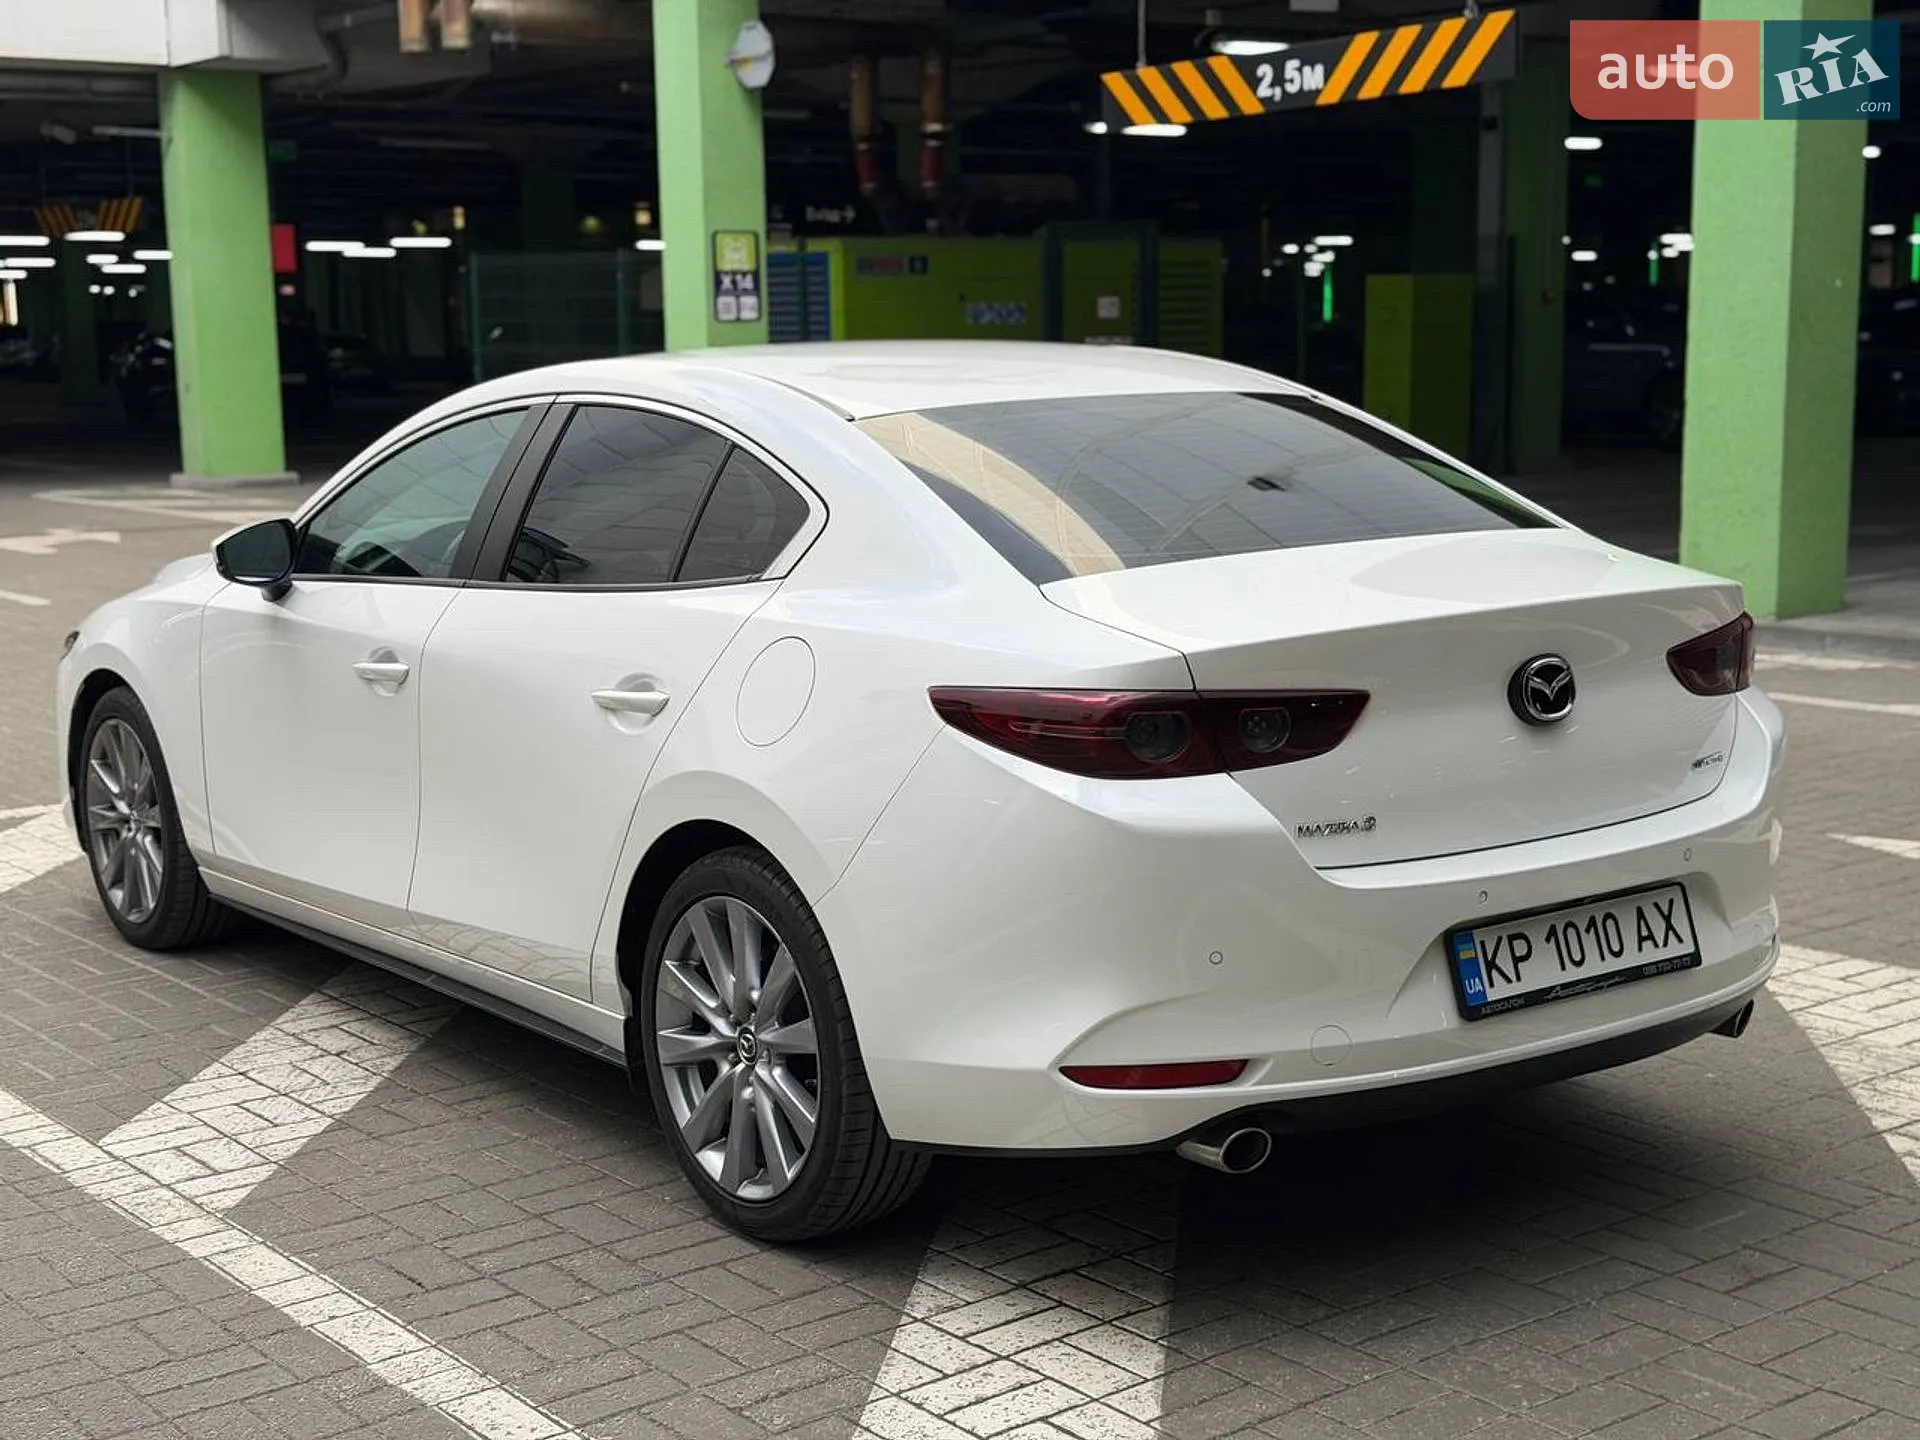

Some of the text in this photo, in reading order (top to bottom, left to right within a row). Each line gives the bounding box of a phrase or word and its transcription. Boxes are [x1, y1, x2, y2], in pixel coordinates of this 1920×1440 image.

[1479, 931, 1533, 988] KP
[1544, 911, 1625, 972] 1010
[1636, 898, 1685, 953] AX
[1465, 976, 1484, 994] UA
